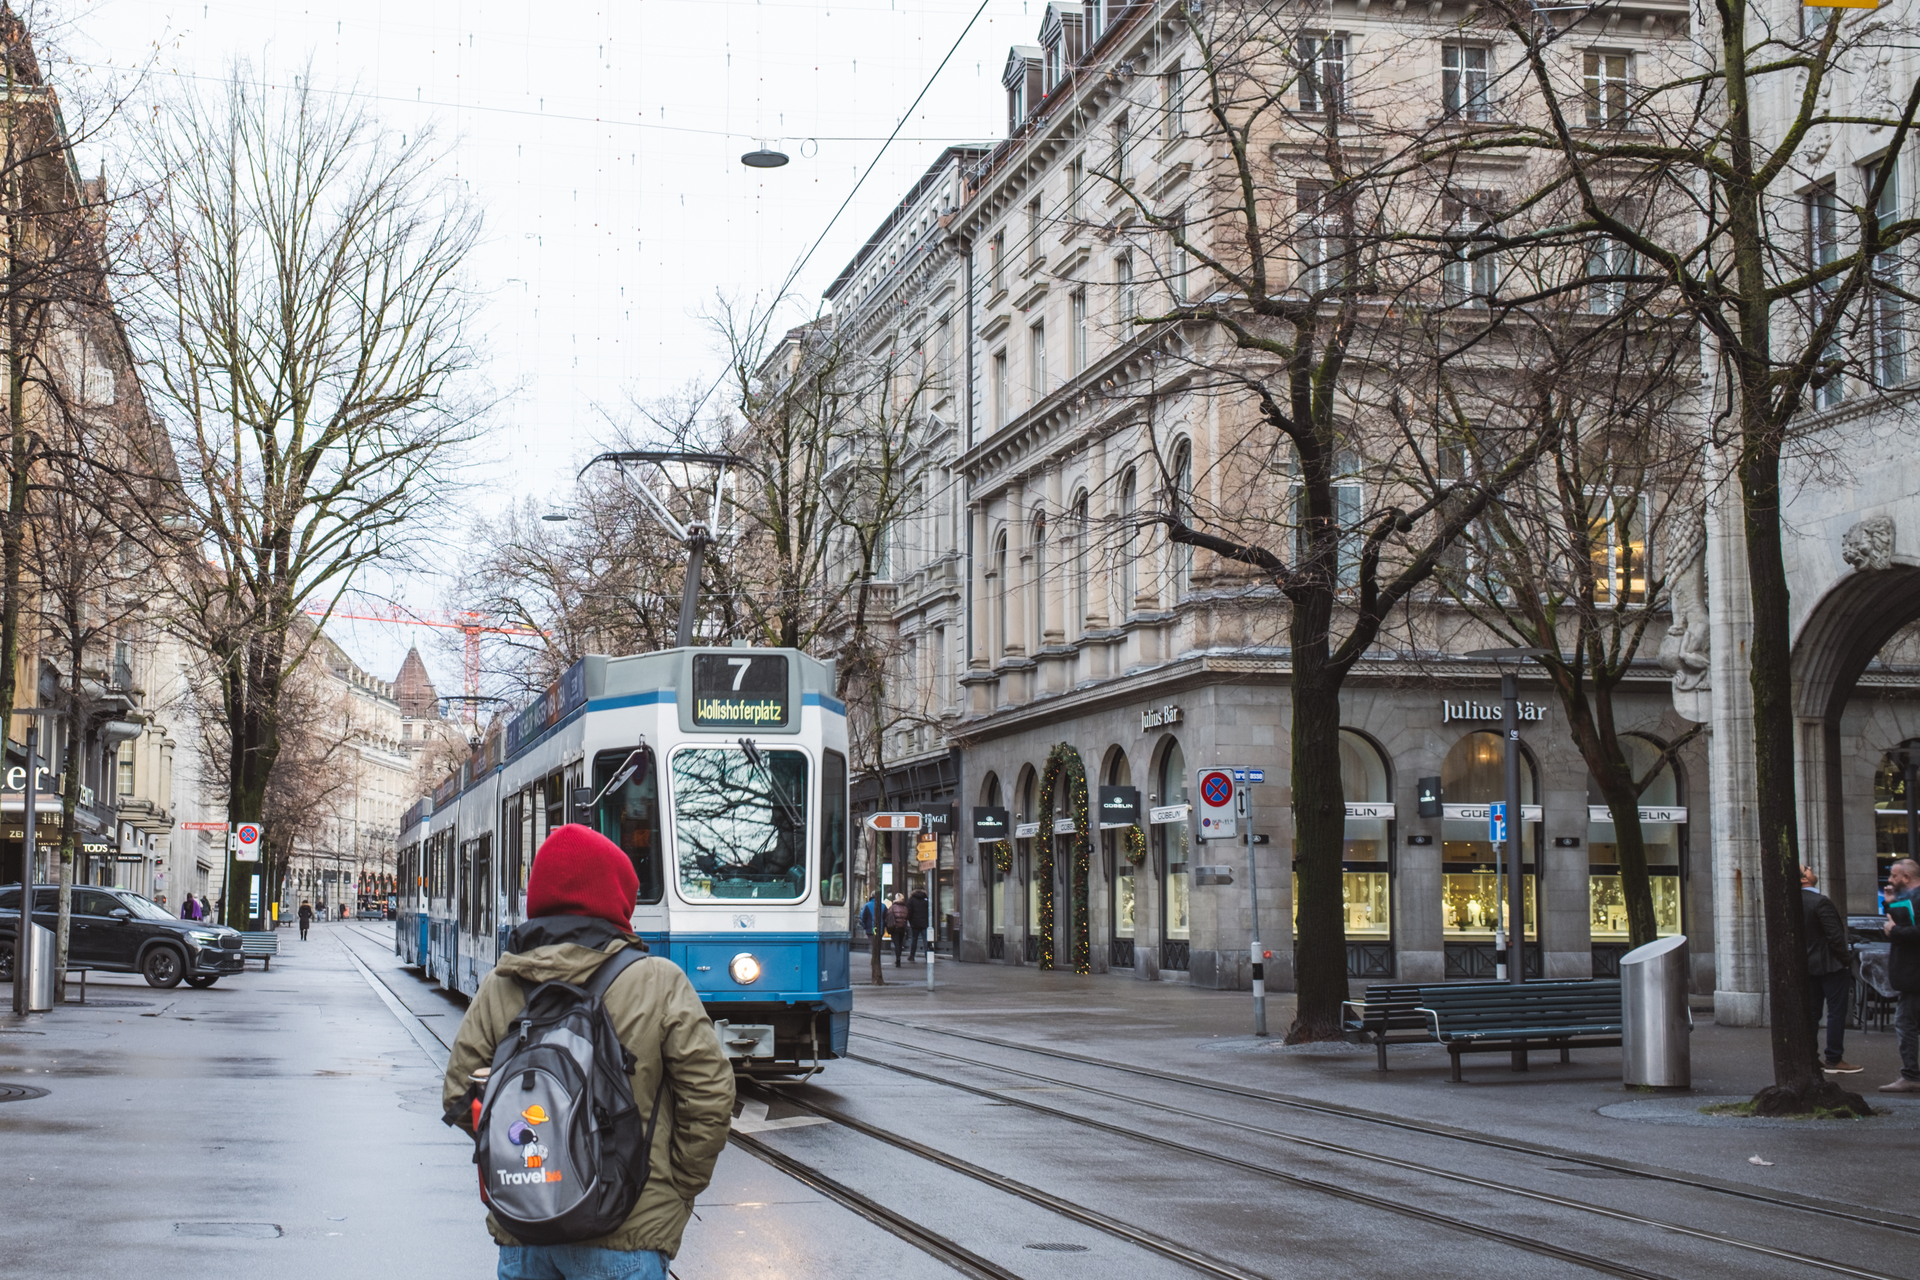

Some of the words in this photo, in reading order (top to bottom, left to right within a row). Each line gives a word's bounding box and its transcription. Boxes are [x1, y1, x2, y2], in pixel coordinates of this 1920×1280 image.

[728, 658, 751, 691] 7
[698, 699, 782, 725] Wollishoferplatz
[1141, 709, 1162, 733] Julius
[1163, 704, 1178, 724] Bär
[1443, 700, 1503, 723] Julius
[1345, 808, 1377, 816] ELIN
[1607, 811, 1671, 820] GELIN
[83, 844, 108, 853] TOD'S
[497, 1167, 562, 1185] Travel365
